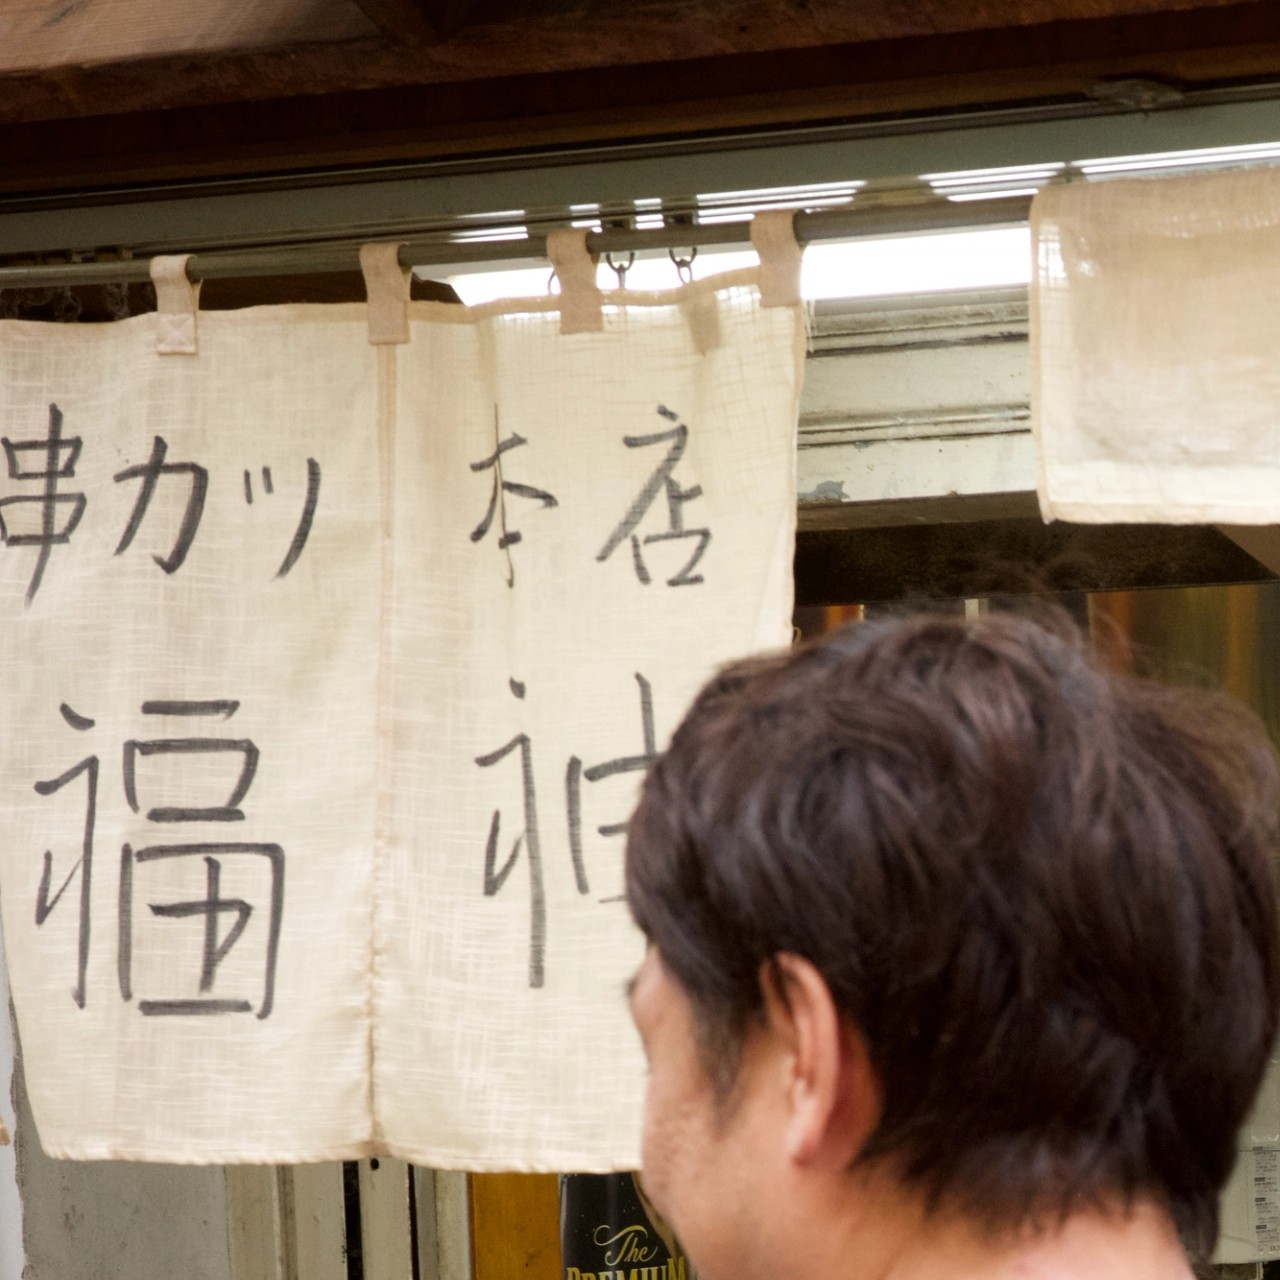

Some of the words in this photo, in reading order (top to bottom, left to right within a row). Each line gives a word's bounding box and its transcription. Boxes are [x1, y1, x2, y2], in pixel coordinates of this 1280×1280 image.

[0, 405, 321, 598] 串カツ
[470, 405, 712, 587] 本店
[35, 700, 285, 1019] 福
[593, 1224, 659, 1266] The
